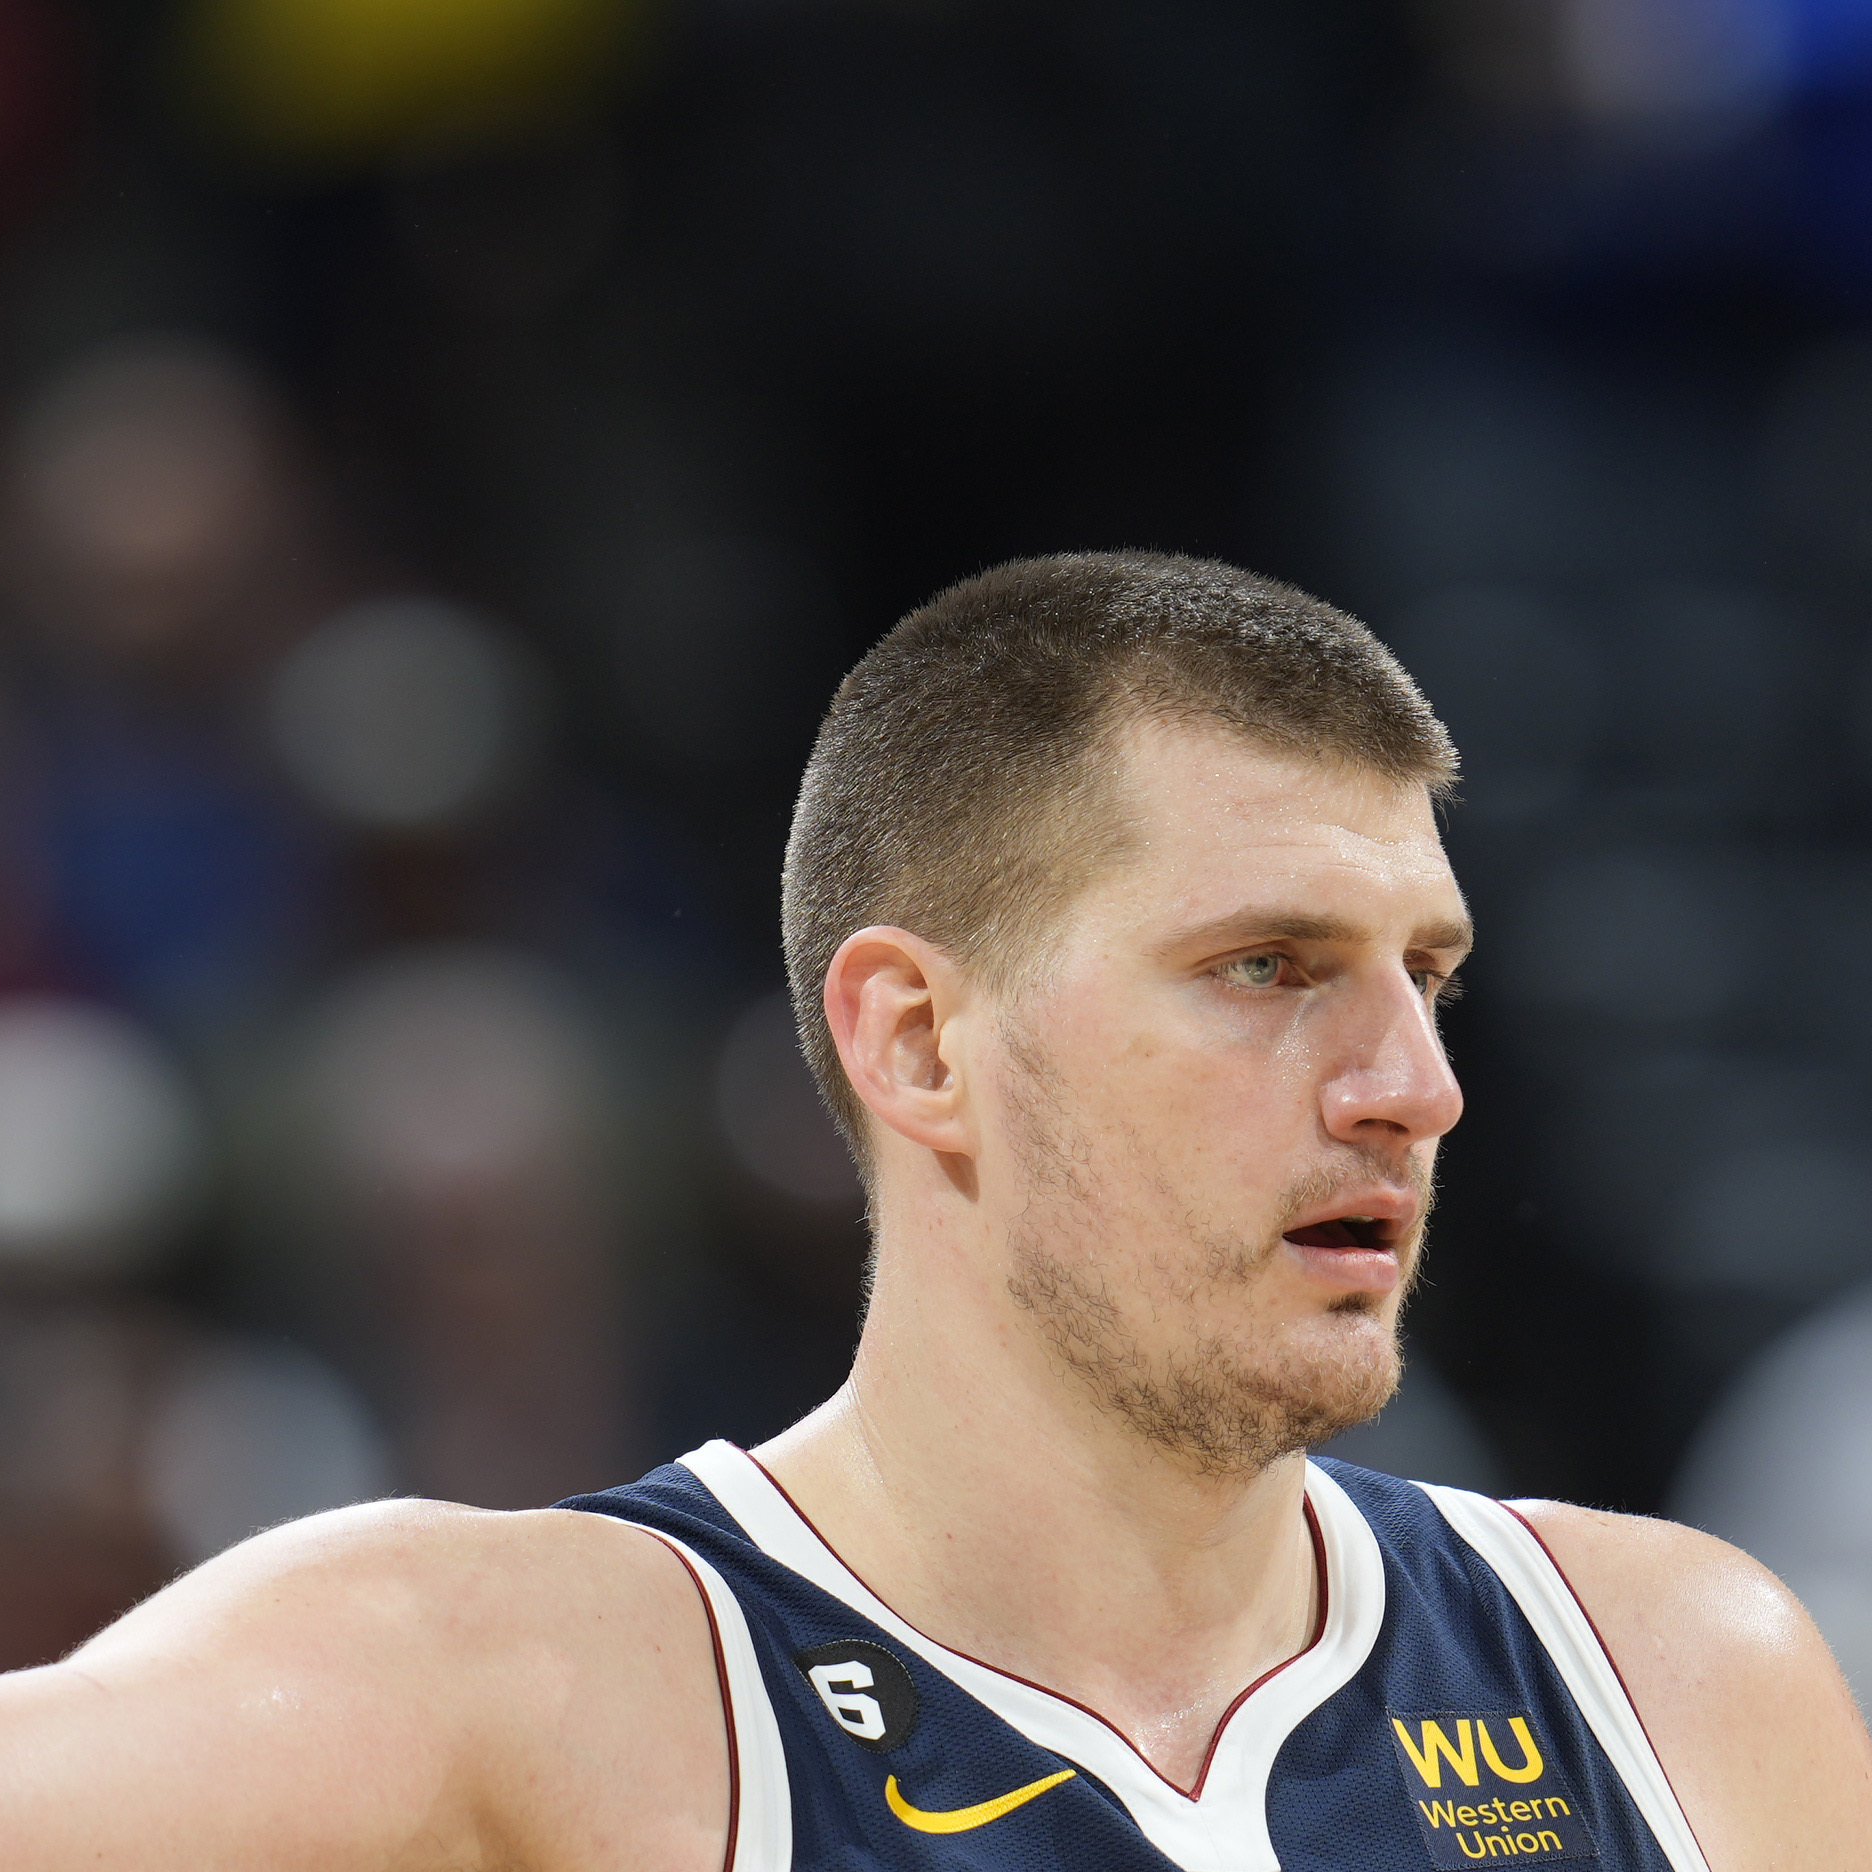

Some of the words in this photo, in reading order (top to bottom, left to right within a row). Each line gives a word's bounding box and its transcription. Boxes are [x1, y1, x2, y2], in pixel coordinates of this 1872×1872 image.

[807, 1660, 888, 1742] 6
[1389, 1715, 1546, 1789] WU
[1418, 1794, 1572, 1831] Western
[1455, 1826, 1564, 1860] Union
